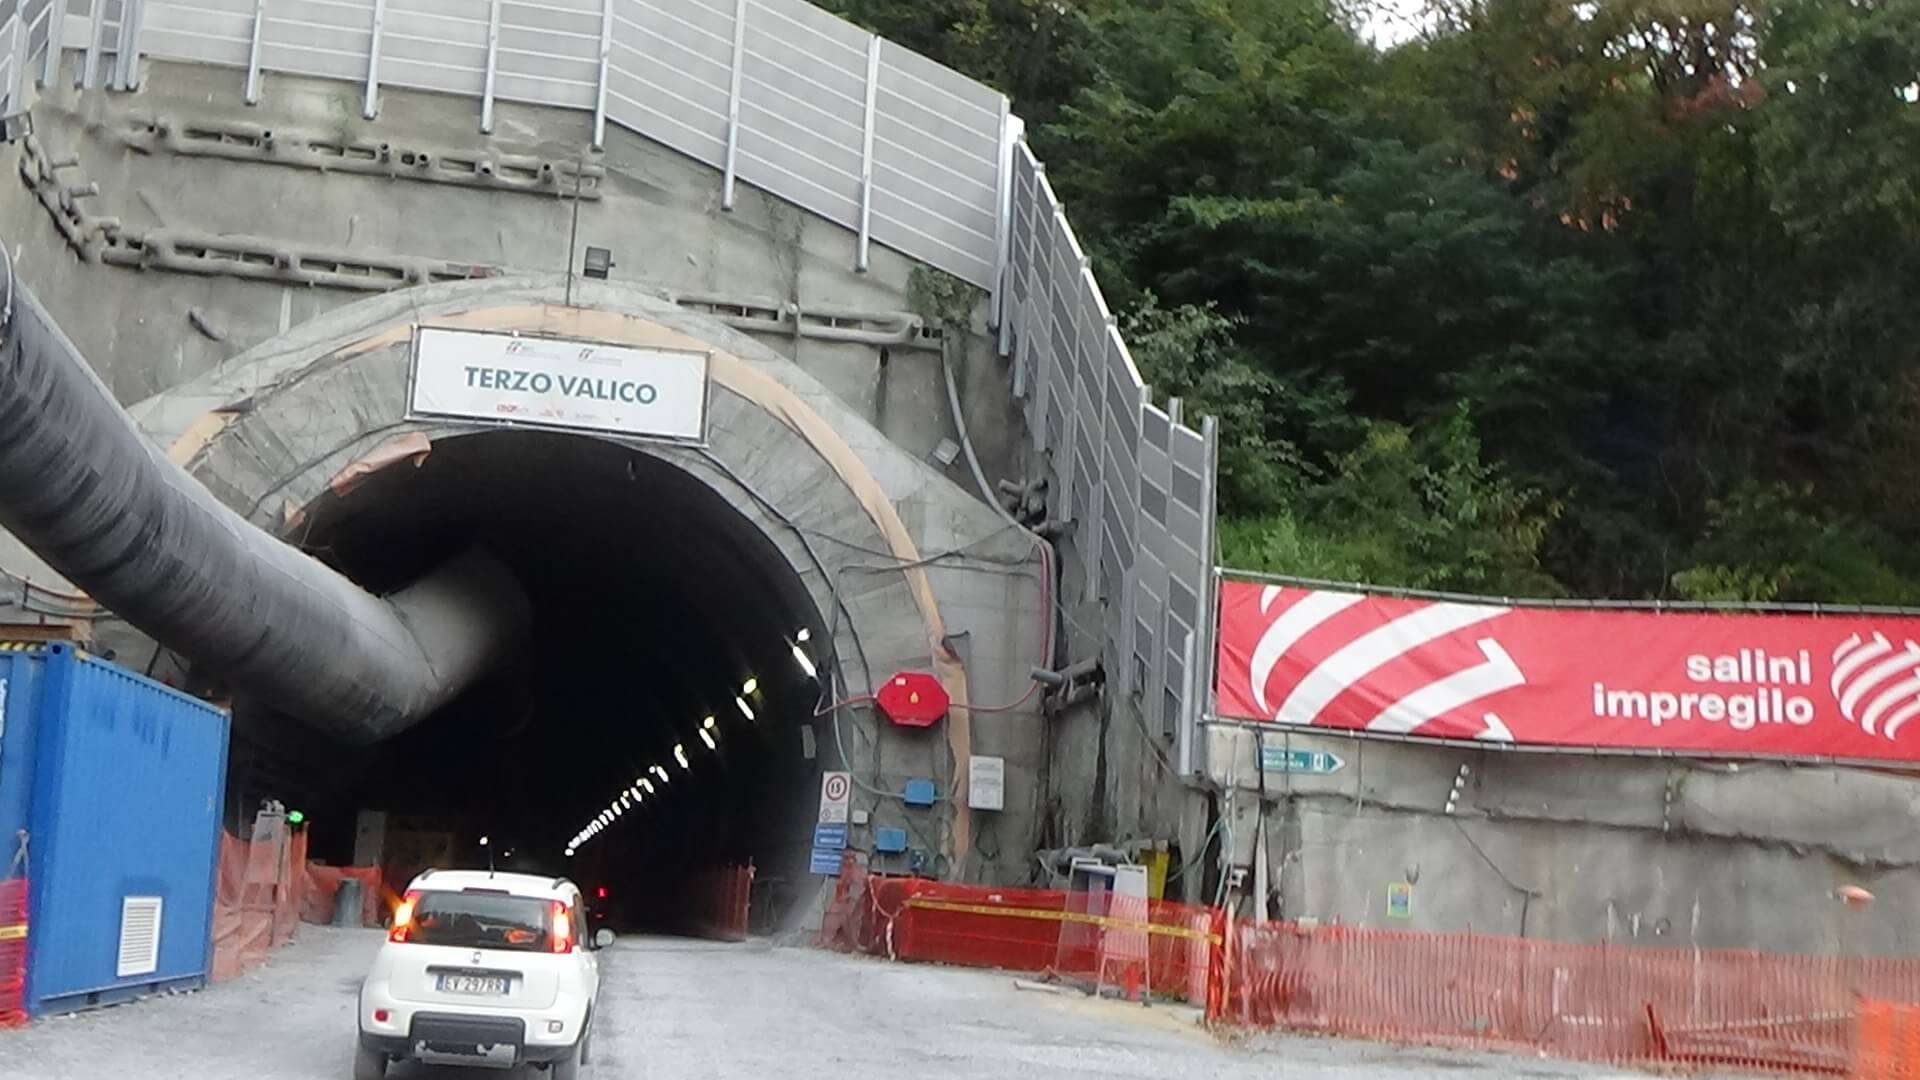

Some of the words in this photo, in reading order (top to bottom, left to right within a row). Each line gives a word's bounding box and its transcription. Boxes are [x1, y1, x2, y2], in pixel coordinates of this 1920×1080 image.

[464, 366, 552, 393] TERZO
[558, 375, 657, 404] VALICO
[1686, 648, 1811, 685] salini
[1593, 681, 1814, 729] impregilo
